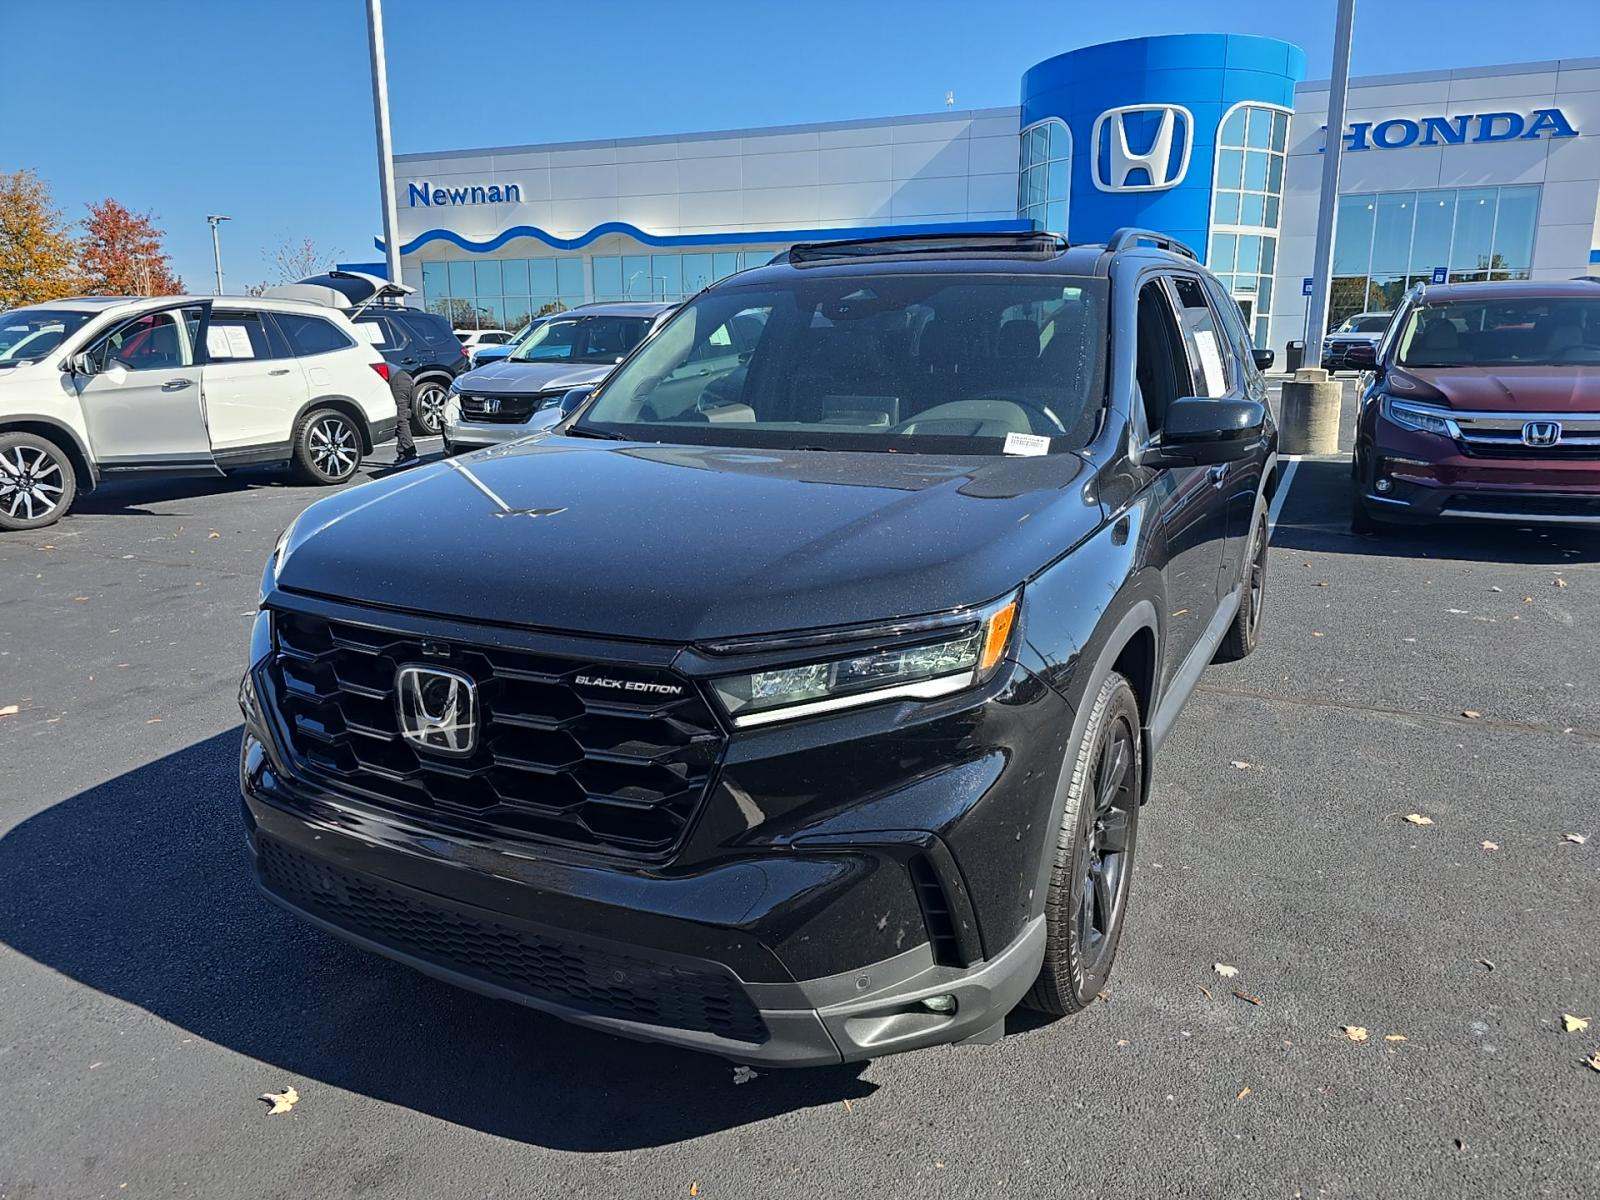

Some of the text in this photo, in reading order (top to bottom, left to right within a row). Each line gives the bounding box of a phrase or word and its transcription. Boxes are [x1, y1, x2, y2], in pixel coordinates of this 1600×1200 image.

[1318, 108, 1580, 152] HONDA
[408, 182, 521, 207] Newnan
[575, 675, 683, 695] BLACK EDITION
